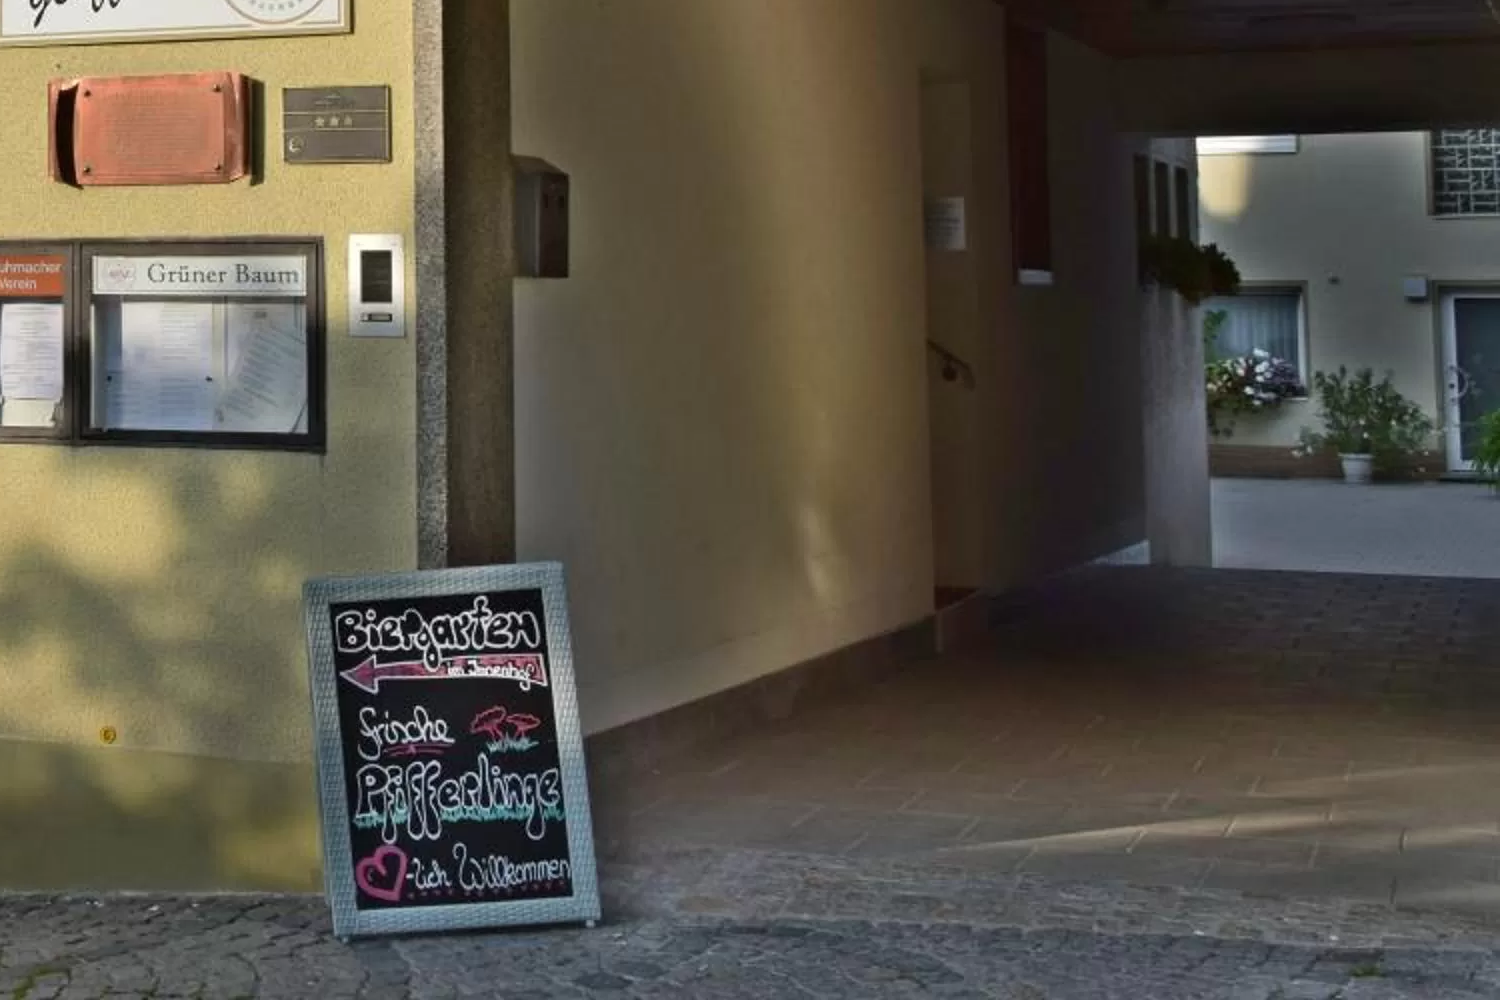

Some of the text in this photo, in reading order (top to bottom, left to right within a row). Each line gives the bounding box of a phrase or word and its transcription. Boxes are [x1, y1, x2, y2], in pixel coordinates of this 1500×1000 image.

[147, 263, 227, 283] Grüner
[234, 263, 298, 283] Baum
[335, 596, 541, 672] Biergarten
[356, 752, 560, 844] Pfifferlinge
[452, 842, 571, 890] Willkommen
